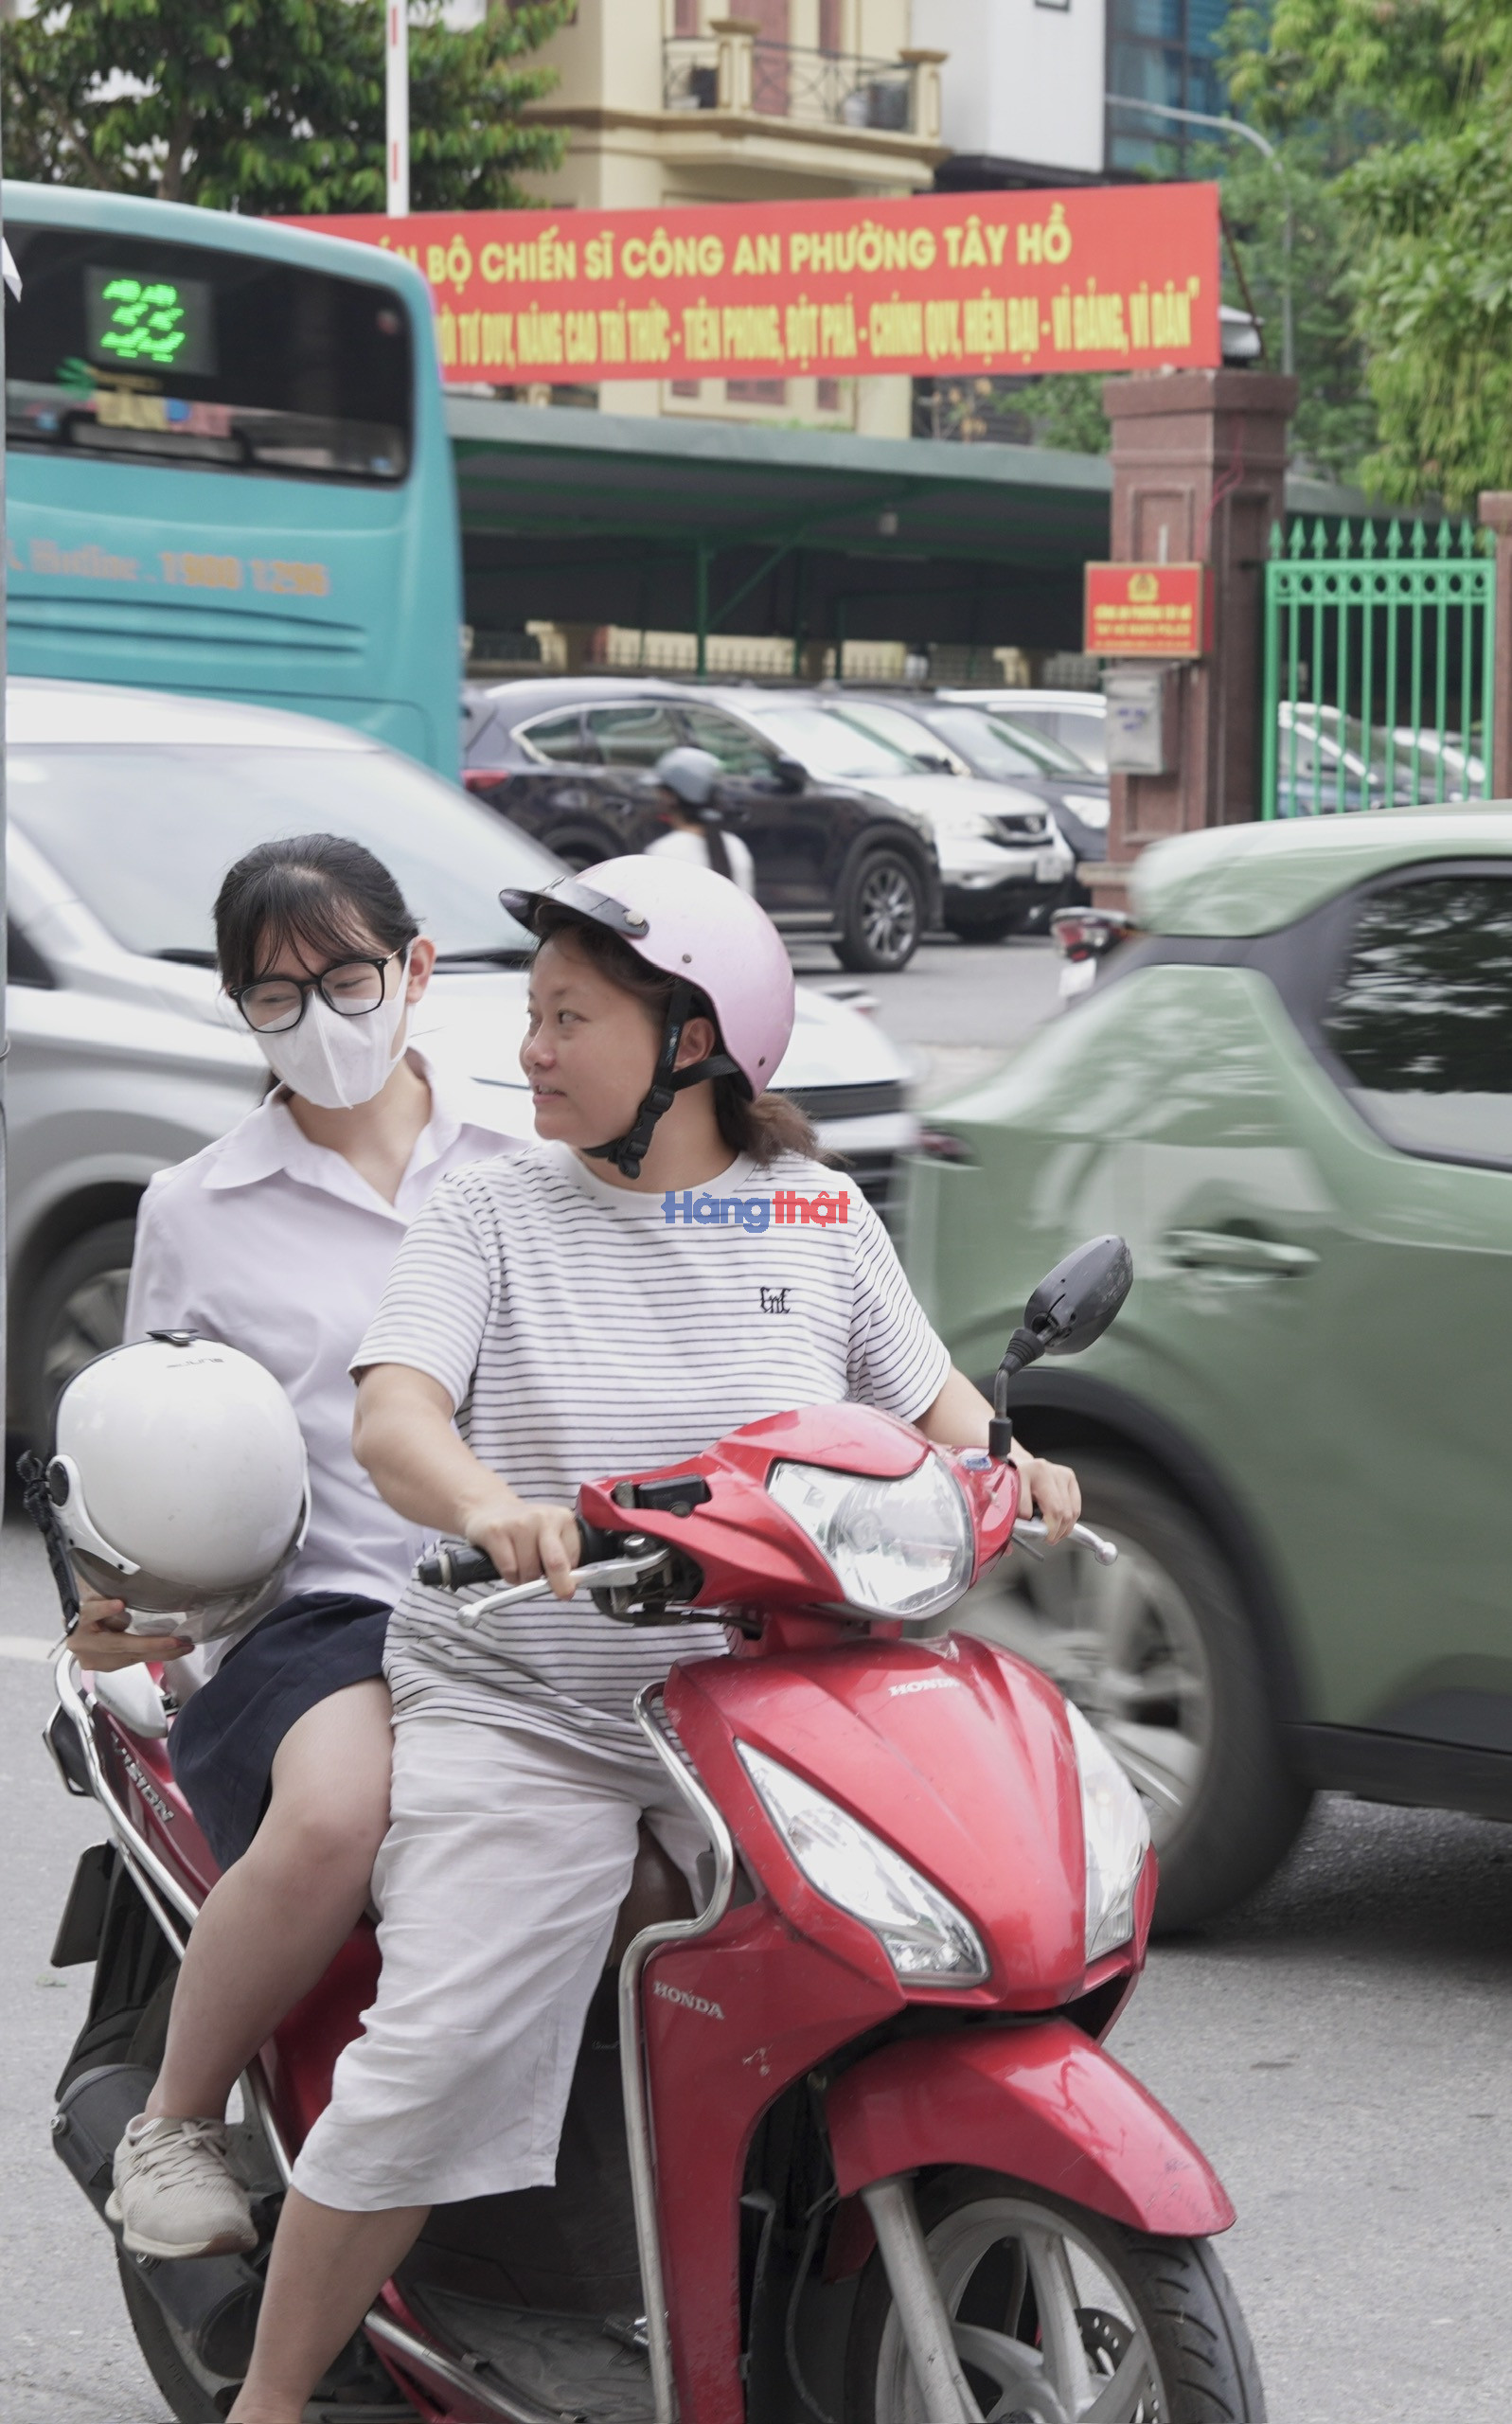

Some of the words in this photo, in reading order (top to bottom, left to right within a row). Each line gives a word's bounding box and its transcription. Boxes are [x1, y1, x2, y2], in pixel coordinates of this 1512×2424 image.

[426, 233, 472, 294] BỘ
[480, 224, 577, 283] CHIẾN
[584, 231, 614, 280] SĨ
[621, 226, 725, 279] CÔNG
[732, 234, 781, 276] AN
[790, 219, 936, 274] PHƯỜNG
[943, 214, 1008, 268] TÂY
[1017, 202, 1072, 265] HỒ
[888, 1674, 961, 1697] HONDA
[652, 1980, 726, 2021] HONDA
